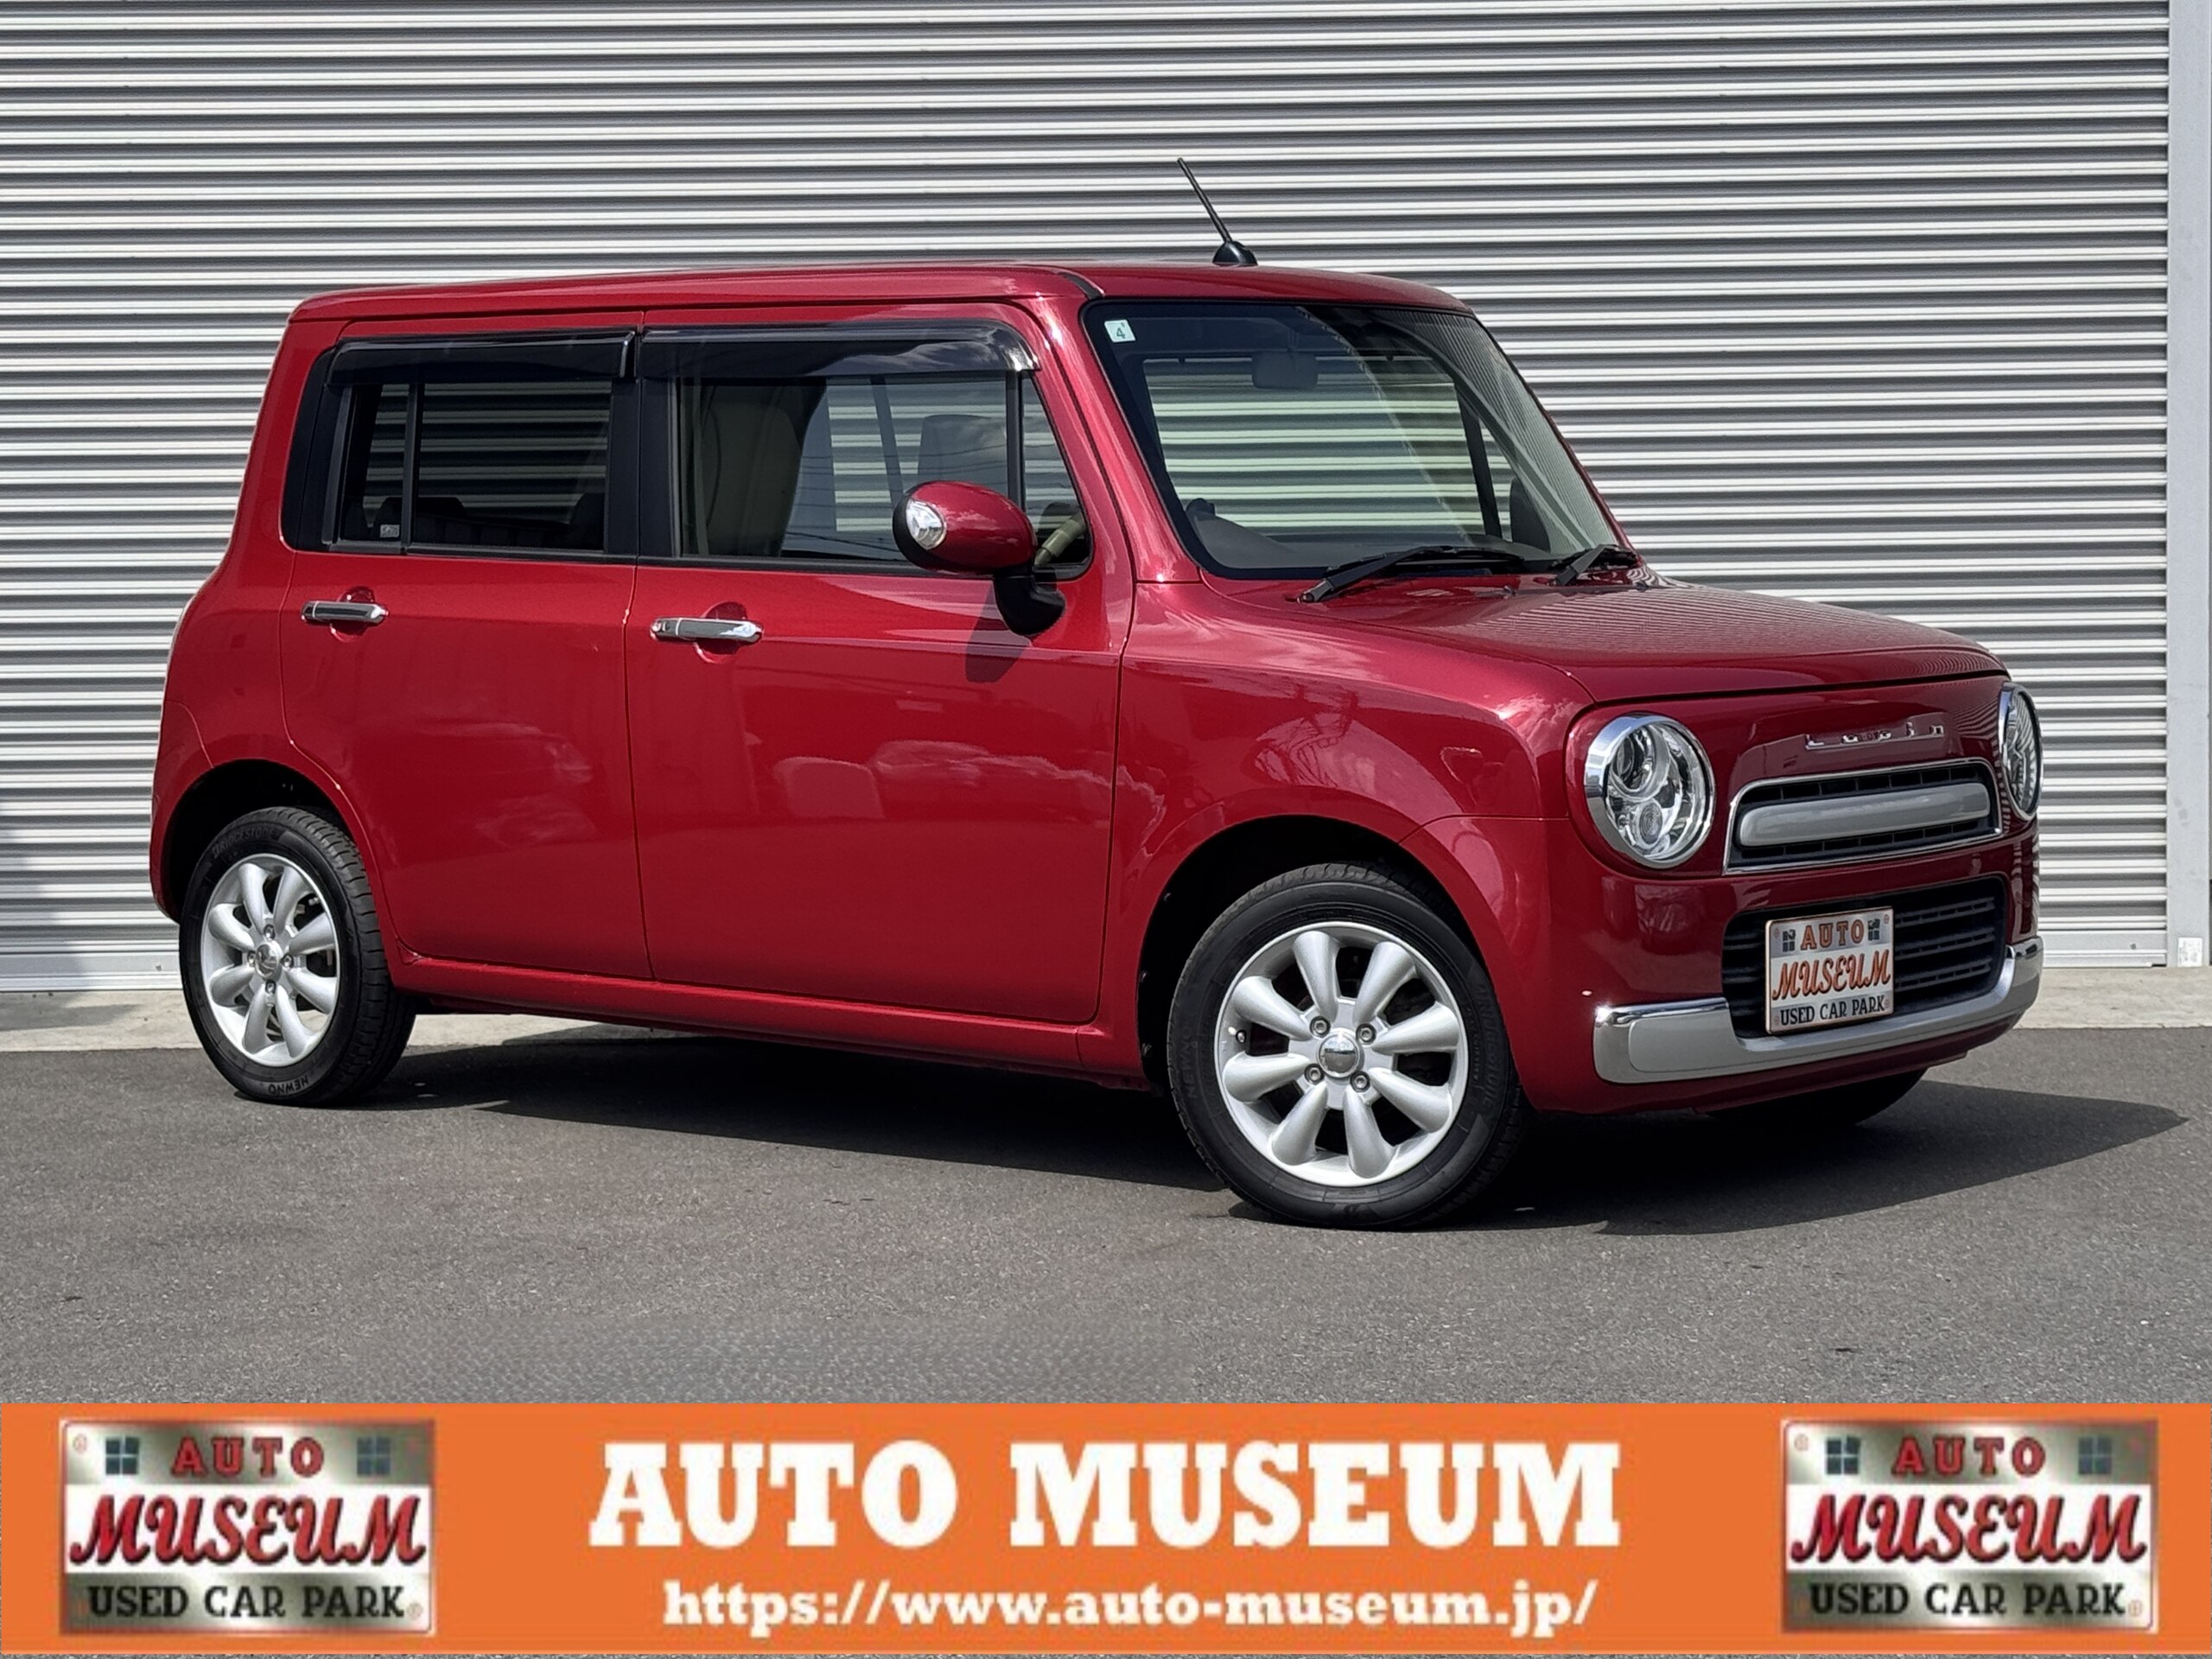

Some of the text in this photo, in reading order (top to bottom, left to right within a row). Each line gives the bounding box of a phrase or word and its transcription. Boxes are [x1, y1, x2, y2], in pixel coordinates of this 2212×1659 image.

[1116, 327, 1126, 339] 4
[1801, 918, 1865, 950] AUTO
[1772, 949, 1891, 1001] MUSEUM
[1780, 995, 1885, 1026] USED CAR PARK
[269, 1076, 309, 1095] NEWNO
